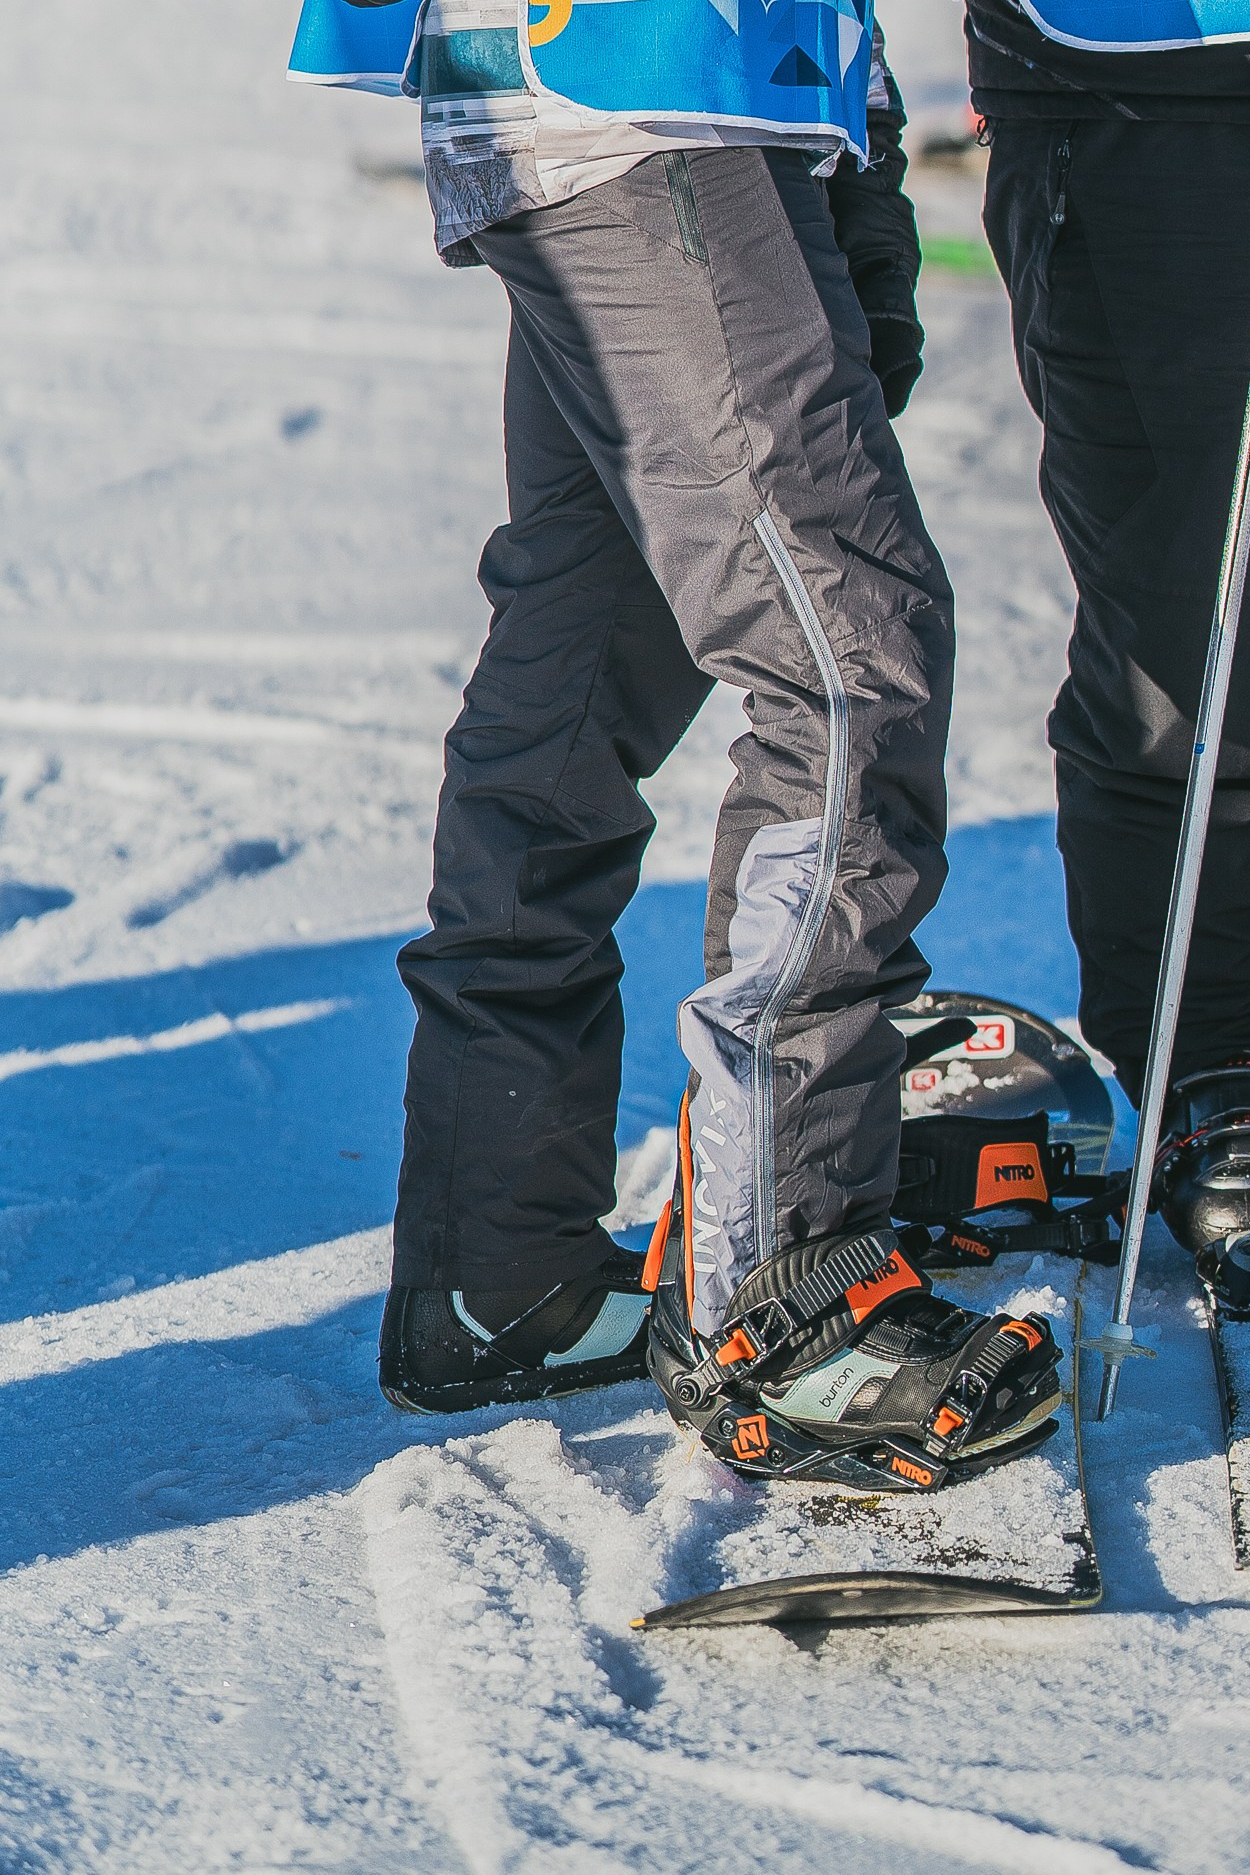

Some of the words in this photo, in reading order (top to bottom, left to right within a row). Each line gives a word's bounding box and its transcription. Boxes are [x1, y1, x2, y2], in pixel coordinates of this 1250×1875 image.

[994, 1163, 1036, 1183] NITRO
[951, 1233, 991, 1258] NITRO
[818, 1366, 855, 1409] burton
[891, 1456, 933, 1486] NITRO
